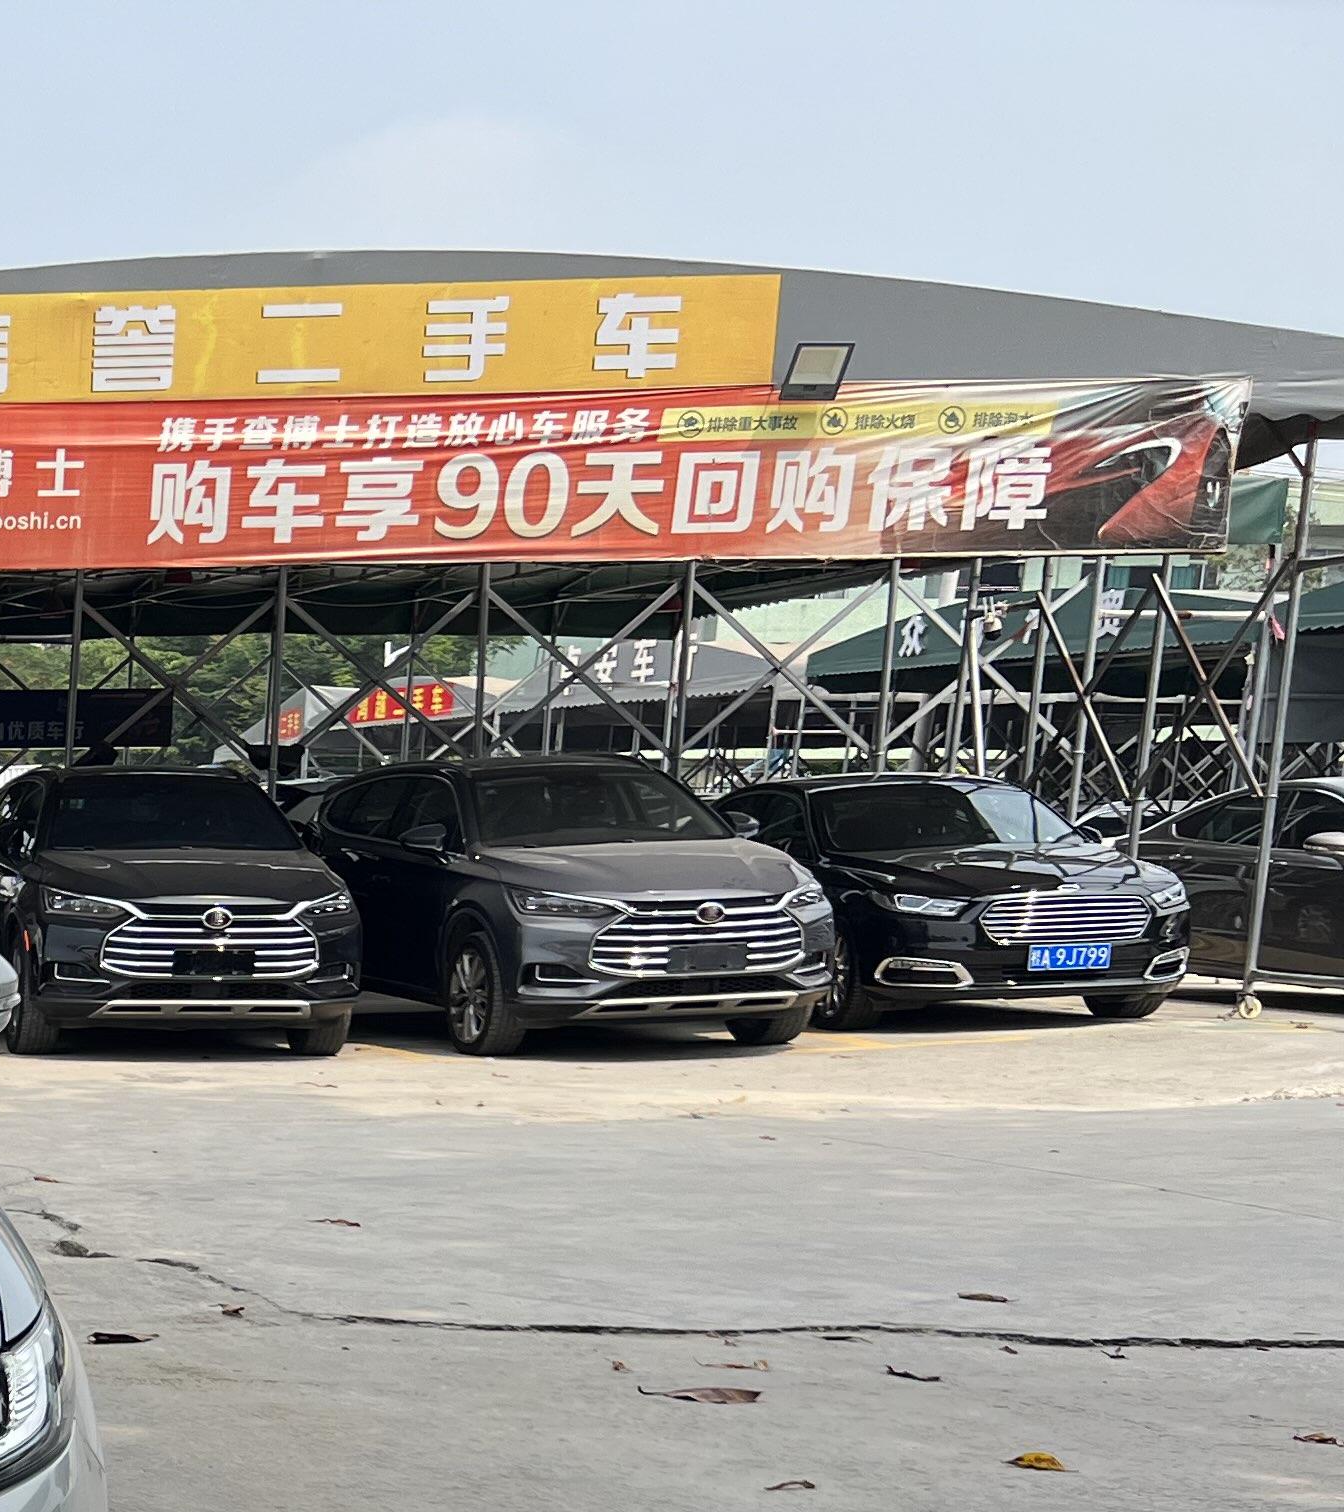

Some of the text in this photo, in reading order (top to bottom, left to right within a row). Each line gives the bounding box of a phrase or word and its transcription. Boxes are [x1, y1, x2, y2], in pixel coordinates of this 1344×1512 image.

[156, 407, 652, 453] 携手查博士打造放心车服务
[706, 414, 799, 432] 排除重大事故
[146, 446, 1053, 546] 购车享90天回购保障
